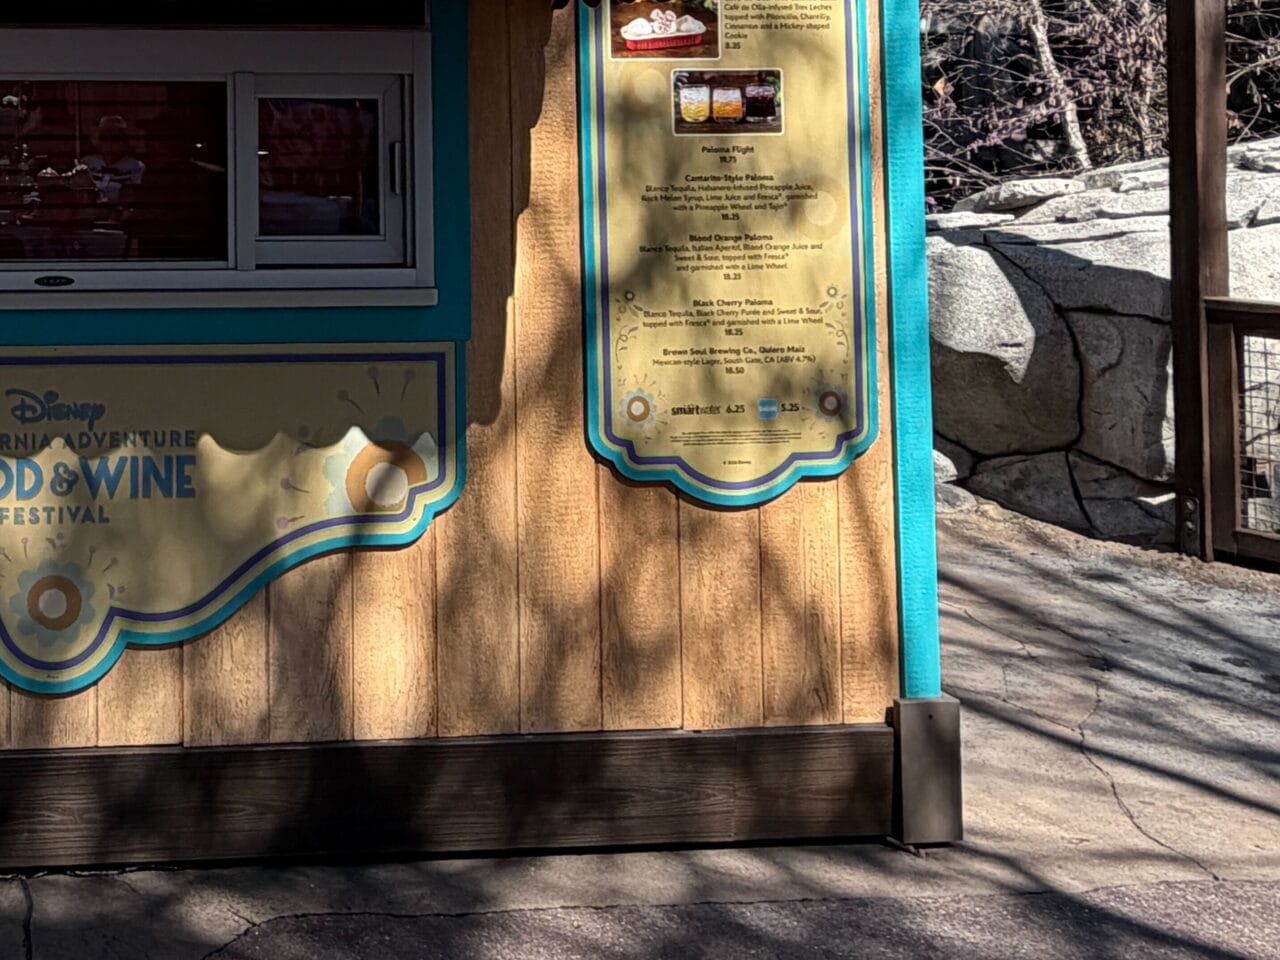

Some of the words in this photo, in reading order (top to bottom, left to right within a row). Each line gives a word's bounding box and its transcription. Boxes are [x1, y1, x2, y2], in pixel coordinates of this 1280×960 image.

[714, 234, 743, 243] Orange
[693, 299, 714, 307] Black
[716, 299, 742, 308] Cherry
[709, 348, 741, 356] Brewing
[6, 388, 106, 430] Disney
[726, 404, 745, 414] 6.25
[780, 403, 800, 412] 5.25
[62, 431, 197, 449] ADVENTURE
[51, 464, 79, 498] &
[76, 455, 197, 500] WINE
